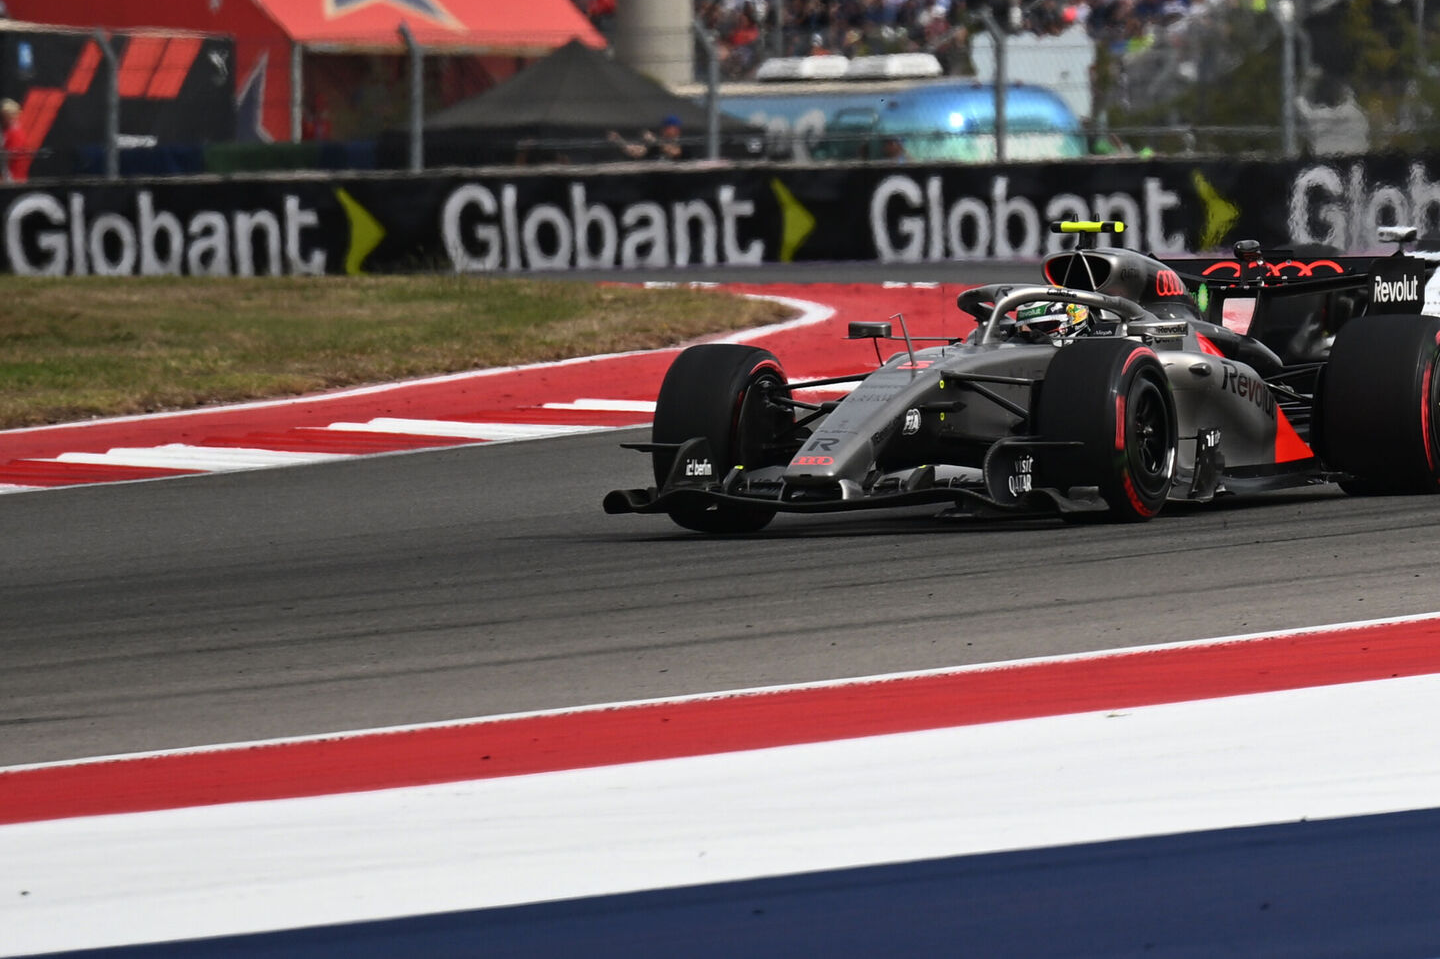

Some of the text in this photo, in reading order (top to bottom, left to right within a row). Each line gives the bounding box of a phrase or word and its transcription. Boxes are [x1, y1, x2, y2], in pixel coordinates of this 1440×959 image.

[6, 191, 327, 277] Globant
[442, 183, 766, 272] Globant
[1374, 274, 1419, 303] Revolut
[1008, 473, 1033, 497] QATAR
